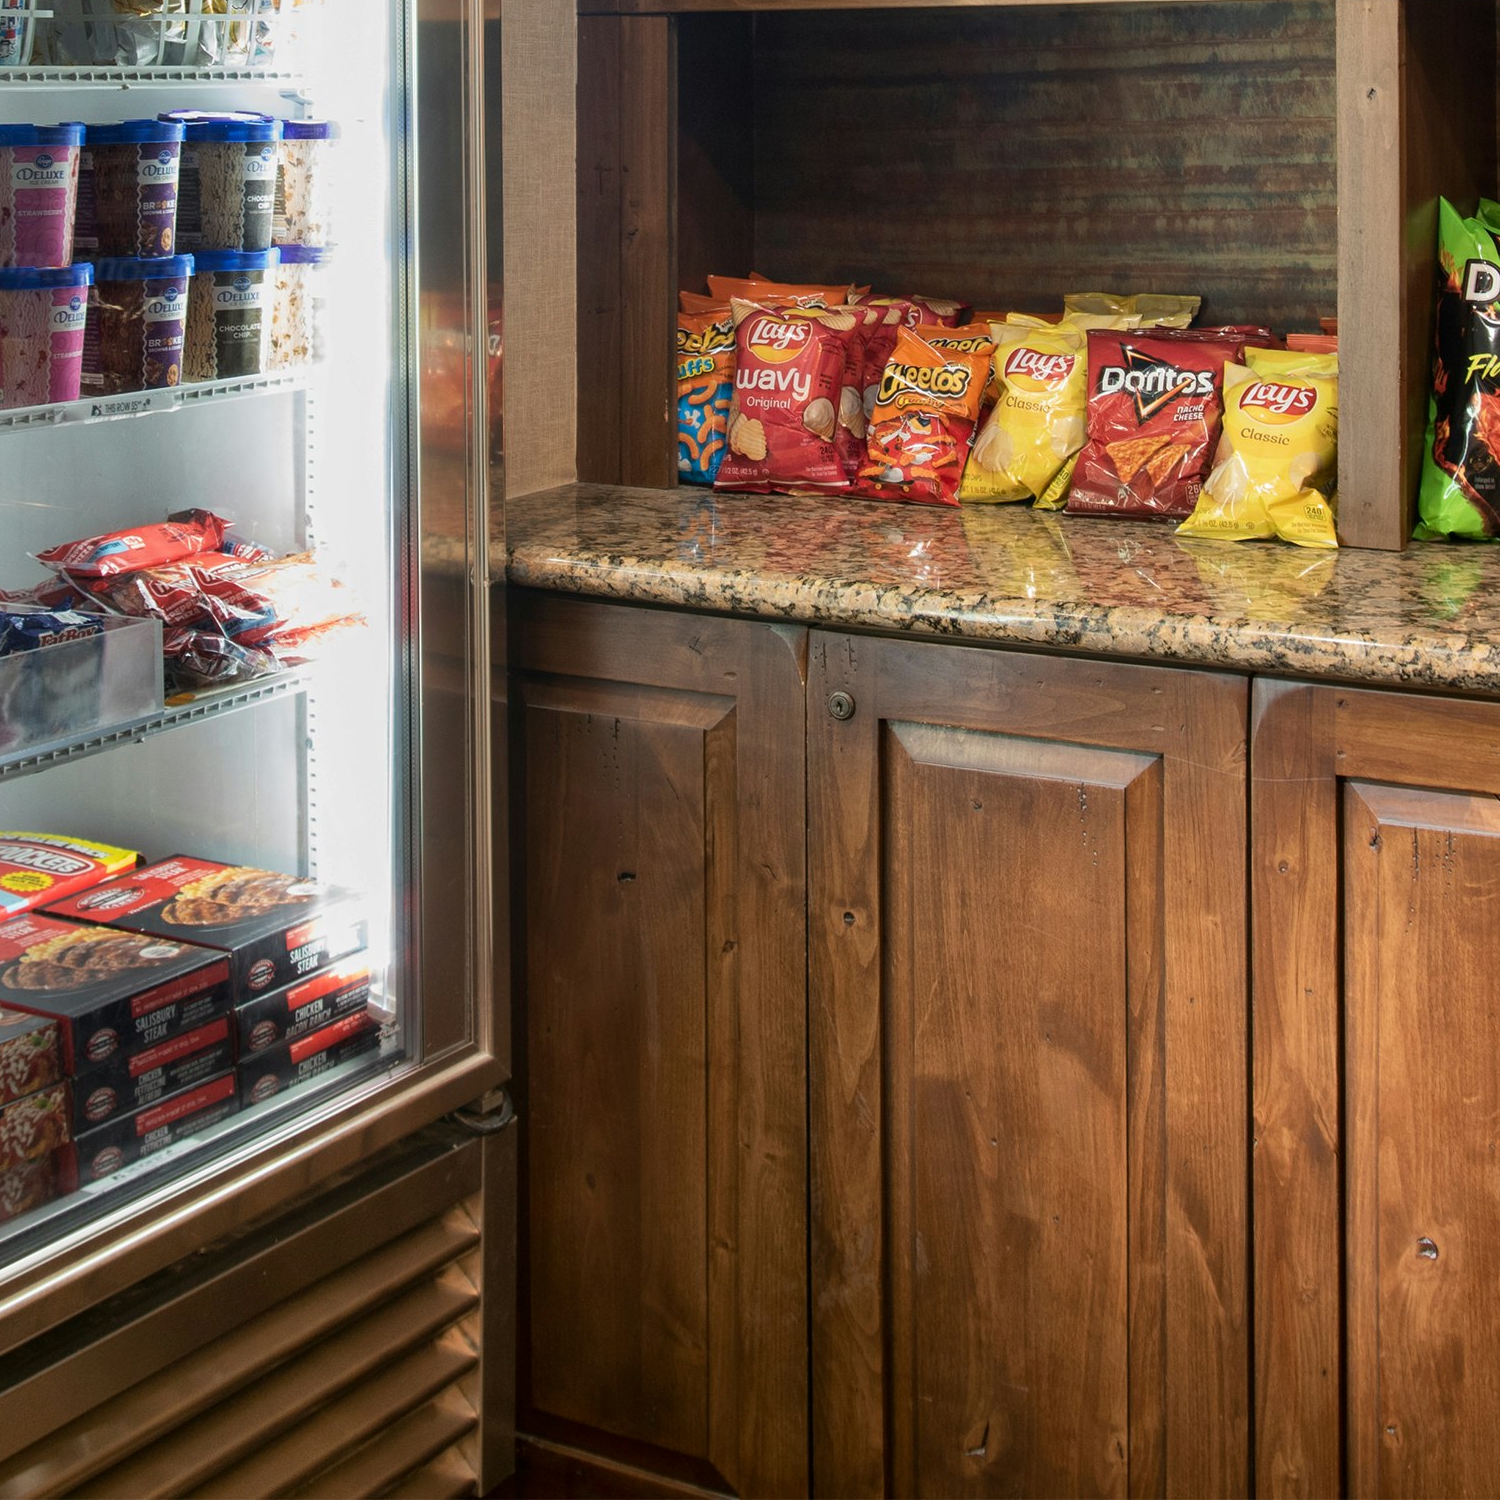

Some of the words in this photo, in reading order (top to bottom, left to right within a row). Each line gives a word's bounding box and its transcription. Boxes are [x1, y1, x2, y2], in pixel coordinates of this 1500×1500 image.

[16, 168, 65, 182] DELUXE
[17, 209, 63, 218] STRAWBERRY
[217, 290, 261, 304] DELUXE
[219, 322, 262, 334] CHOCOLATE
[751, 318, 809, 349] Lay's
[736, 368, 812, 400] wavy
[877, 366, 971, 405] Cheetos
[1102, 366, 1215, 395] Doritos
[105, 403, 115, 413] THIS
[116, 402, 130, 412] ROW
[746, 397, 791, 410] Original
[1005, 396, 1050, 413] Classic
[1177, 404, 1204, 414] NACHO
[1173, 411, 1204, 422] CHEESE
[1240, 427, 1290, 446] Classic
[297, 953, 318, 975] STEAK
[135, 1004, 176, 1033] SALISBURY
[144, 1025, 167, 1044] STEAK
